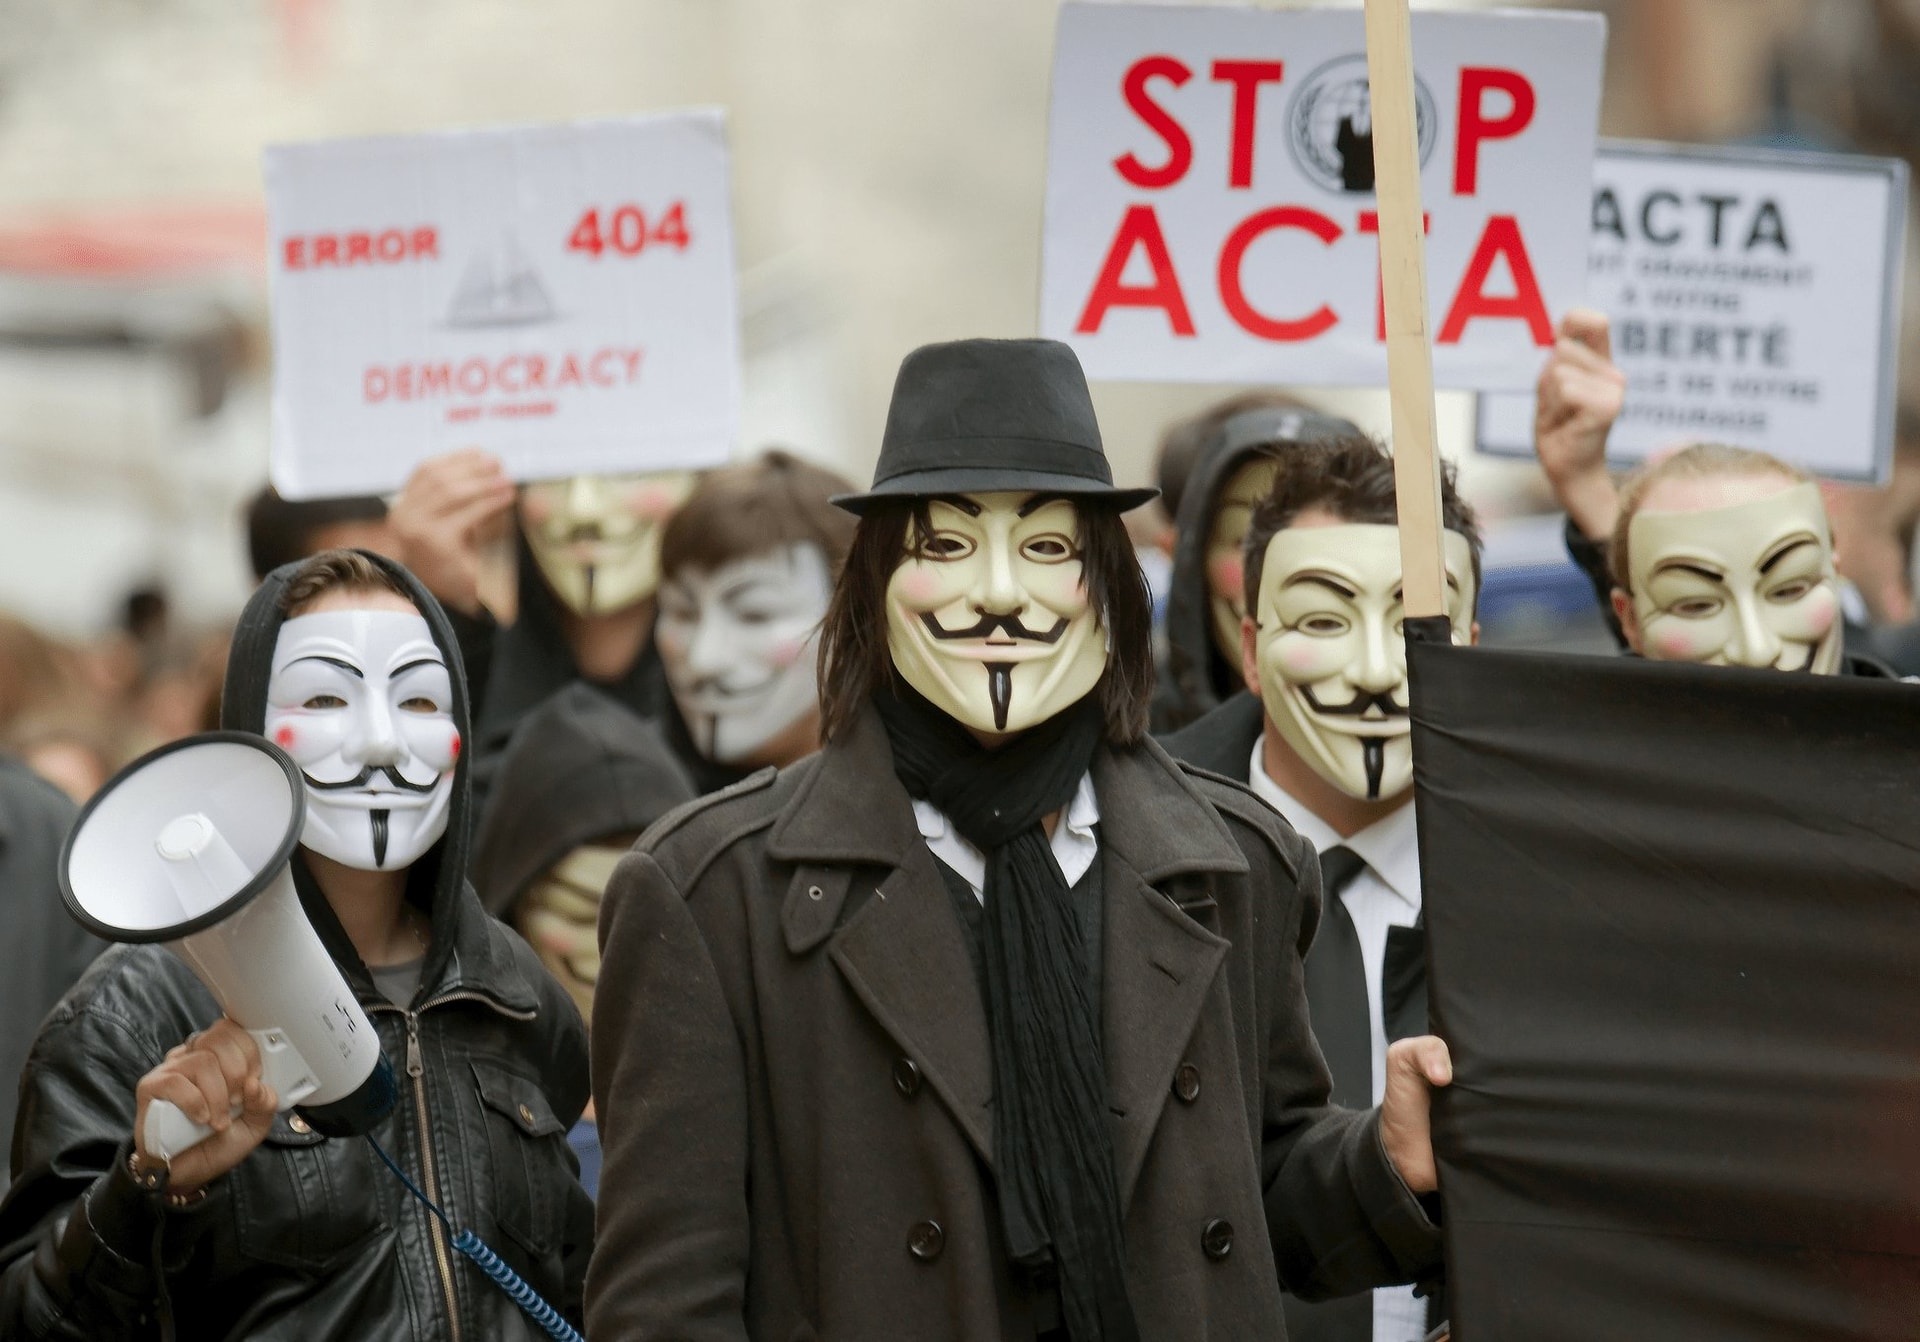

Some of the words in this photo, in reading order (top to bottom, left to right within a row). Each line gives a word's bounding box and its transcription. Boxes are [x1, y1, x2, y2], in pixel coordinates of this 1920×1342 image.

[283, 227, 440, 270] ERROR
[567, 202, 691, 257] 404
[1592, 187, 1790, 251] ACTA
[1621, 321, 1788, 367] BERTÉ
[362, 348, 642, 404] DEMOCRACY
